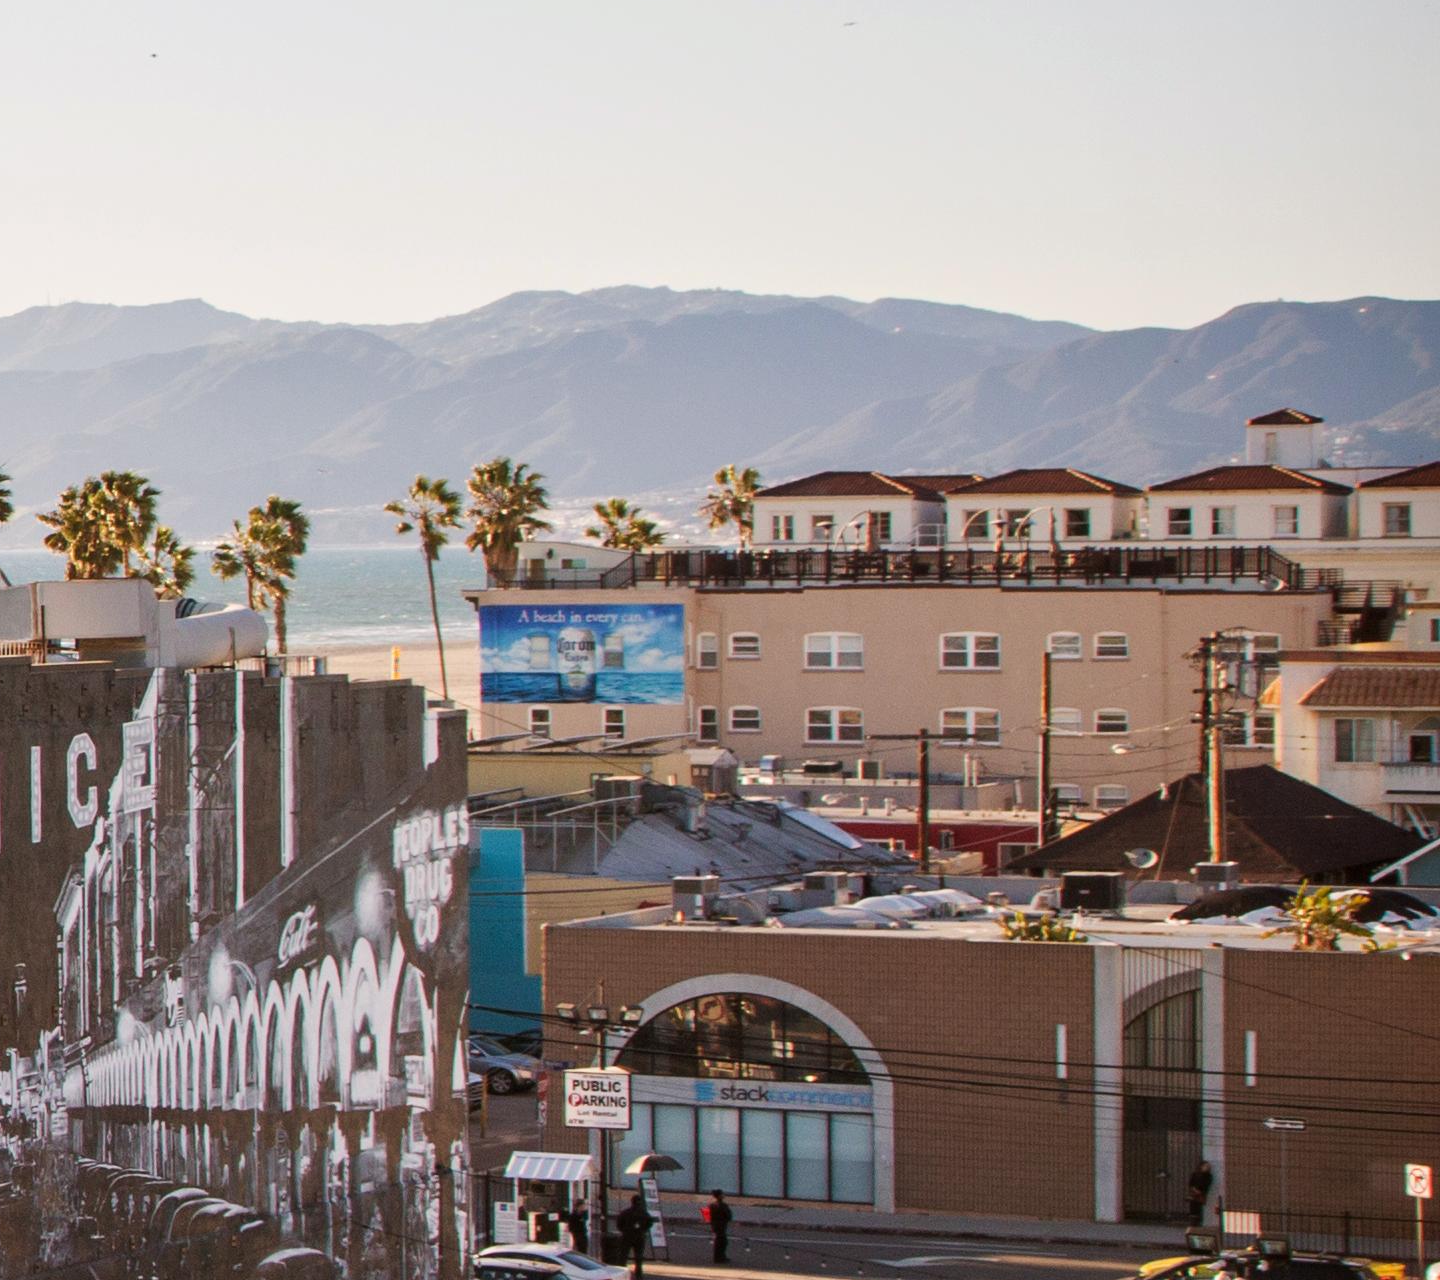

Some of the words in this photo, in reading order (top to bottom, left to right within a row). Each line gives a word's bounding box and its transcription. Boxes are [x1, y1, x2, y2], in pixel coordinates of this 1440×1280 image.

[517, 610, 530, 623] A
[533, 609, 566, 623] beach
[570, 610, 582, 623] in
[584, 612, 618, 625] every
[393, 803, 470, 869] PEOPLES
[404, 857, 454, 905] DRUG
[571, 1079, 622, 1093] PUBLIC
[568, 1092, 627, 1108] PARKING
